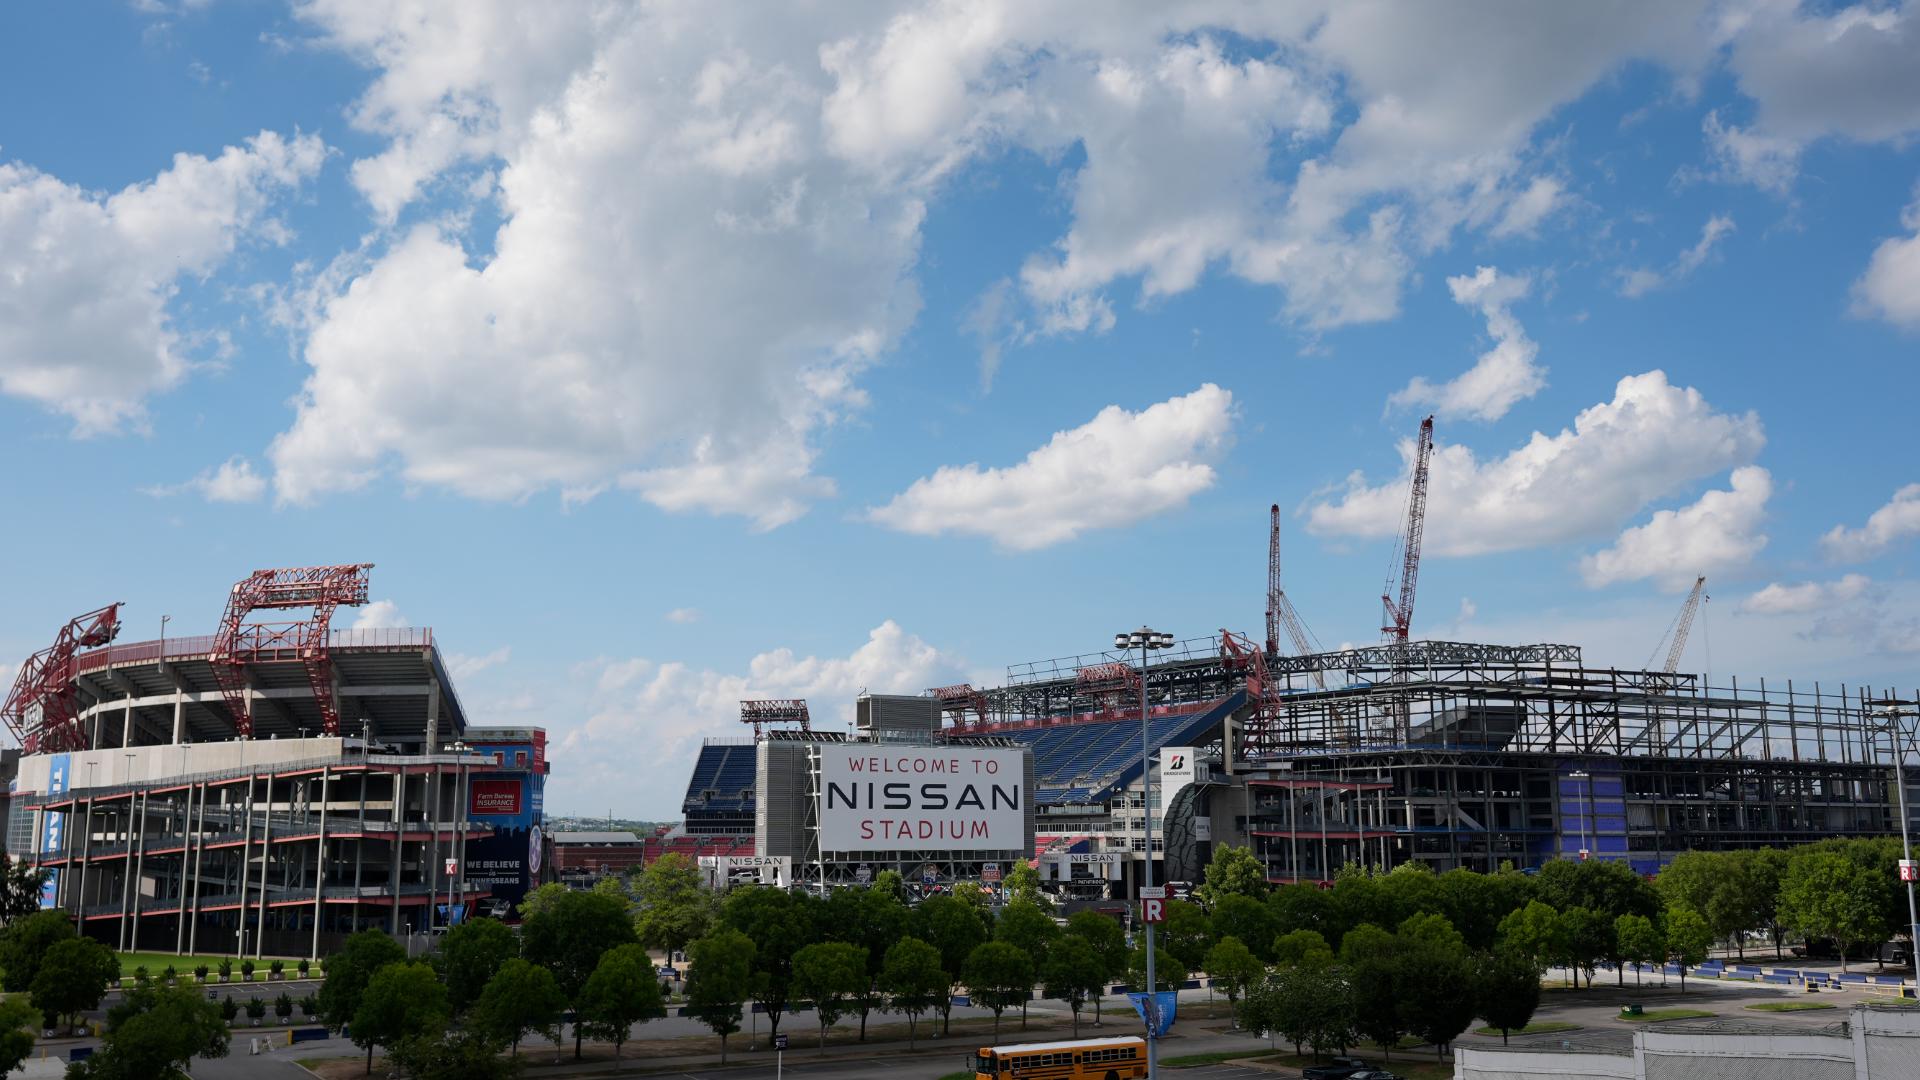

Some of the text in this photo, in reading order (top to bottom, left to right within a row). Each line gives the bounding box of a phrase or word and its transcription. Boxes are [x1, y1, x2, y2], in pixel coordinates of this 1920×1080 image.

[848, 756, 999, 775] WELCOME TO
[827, 781, 1019, 811] NISSAN
[860, 819, 989, 840] STADIUM
[466, 860, 482, 869] WE
[482, 860, 520, 869] BELIEVE
[729, 857, 783, 866] NISSAN
[1071, 854, 1114, 862] NISSAN
[446, 864, 454, 875] K
[1901, 867, 1909, 880] R
[1146, 899, 1163, 921] R
